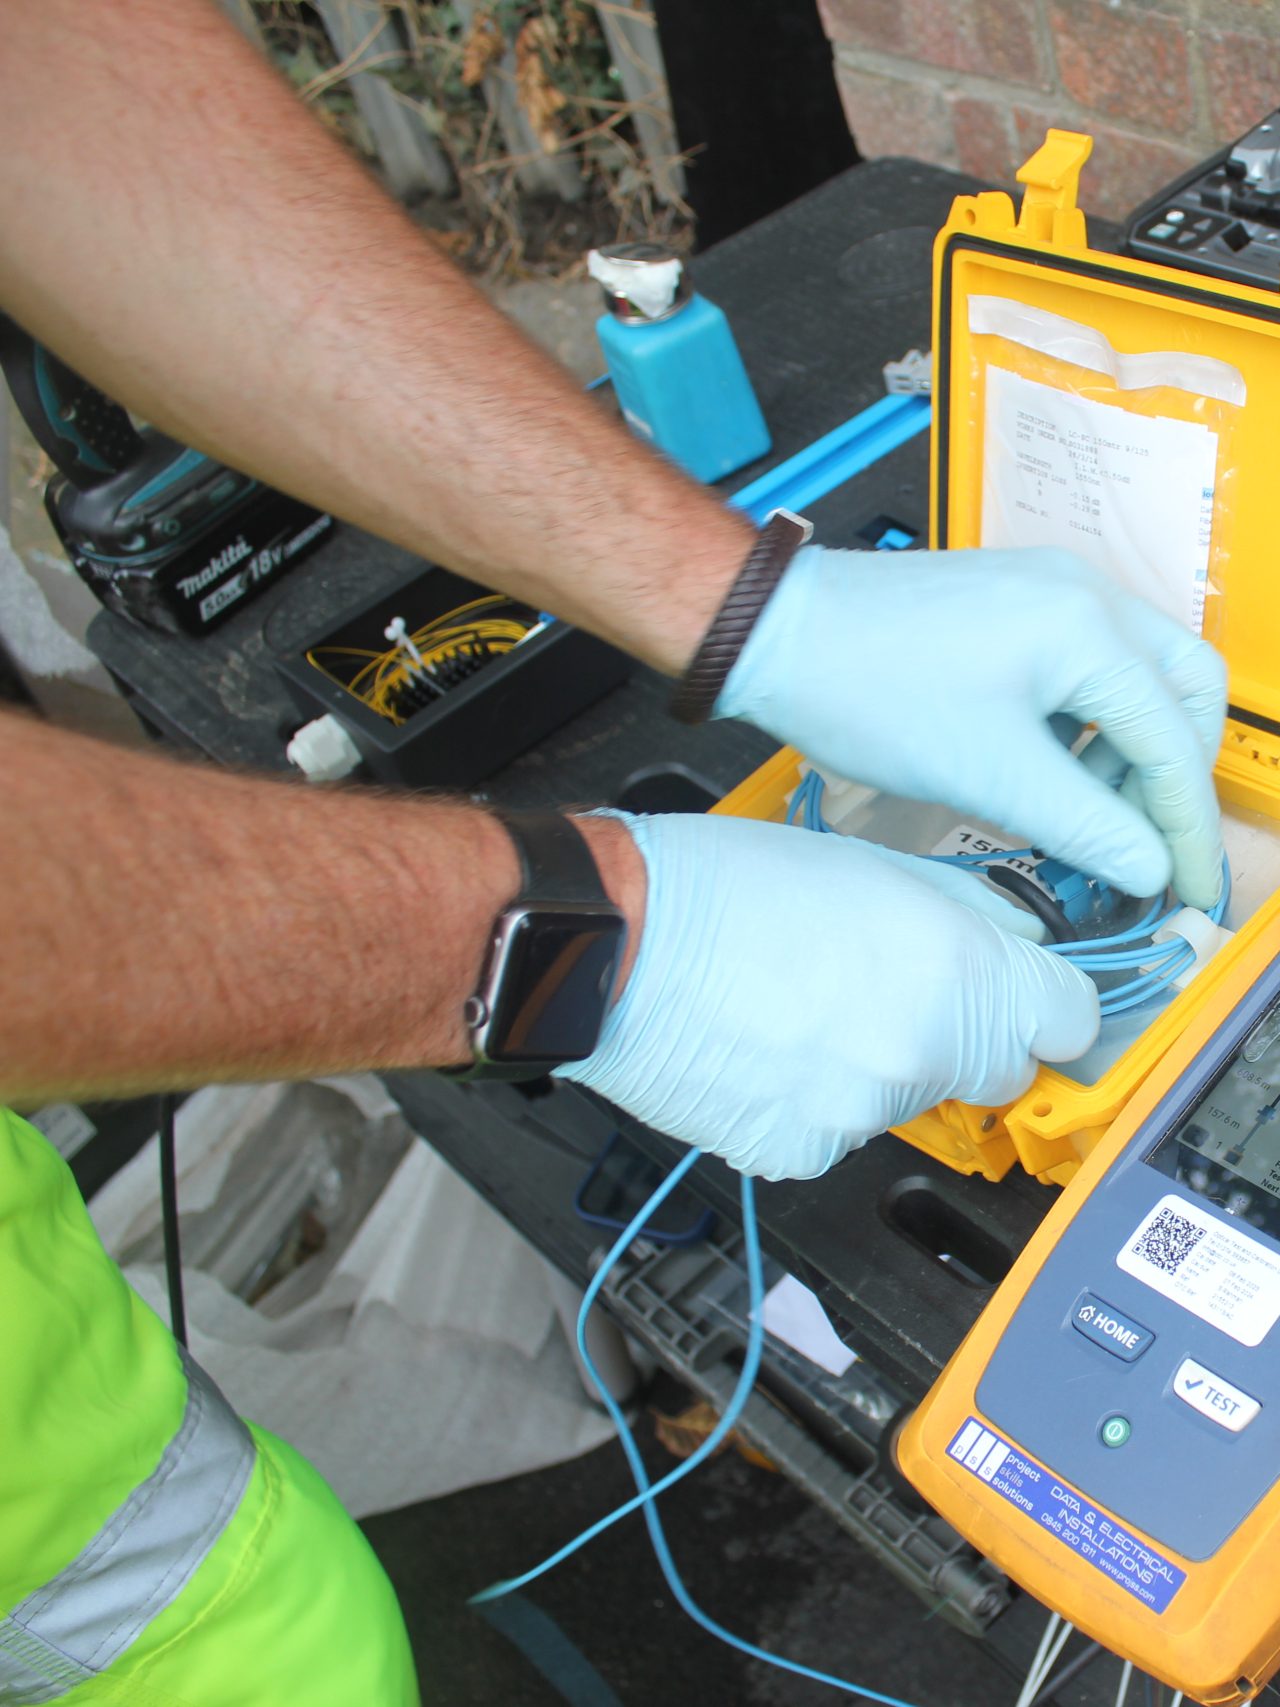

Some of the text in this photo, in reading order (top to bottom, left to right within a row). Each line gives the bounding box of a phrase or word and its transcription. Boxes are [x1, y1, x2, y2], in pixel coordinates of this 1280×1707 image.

[175, 533, 253, 599] makita
[1207, 1105, 1231, 1125] 157.6
[1261, 1178, 1280, 1195] Next
[1092, 1312, 1140, 1350] HOME
[1204, 1386, 1240, 1416] TEST
[999, 1465, 1025, 1488] skills
[1006, 1453, 1042, 1483] project
[991, 1476, 1034, 1512] solutions
[1050, 1485, 1175, 1585] DATA & ELECTRICAL
[1057, 1507, 1156, 1586] INSTALLATIONS
[1040, 1511, 1157, 1604] 0845 200 1311 www.projss.com
